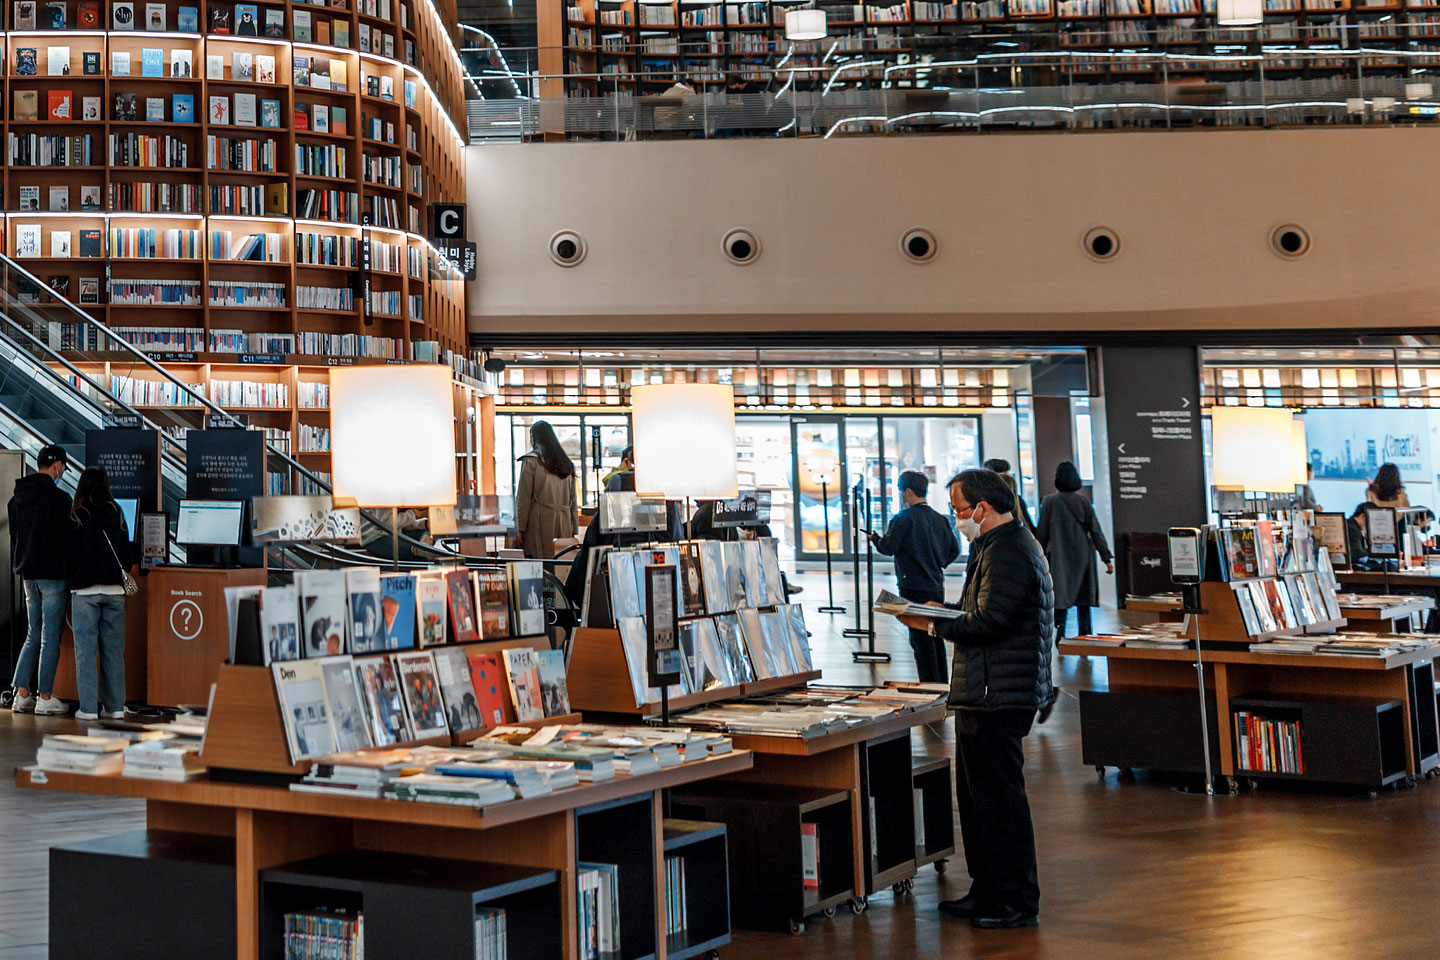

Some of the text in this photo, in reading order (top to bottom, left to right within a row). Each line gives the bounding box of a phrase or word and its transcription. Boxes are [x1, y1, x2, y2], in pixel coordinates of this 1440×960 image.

[440, 210, 458, 234] C
[386, 576, 412, 590] Pitch
[510, 652, 534, 666] PAPER
[280, 667, 296, 680] Den
[402, 660, 434, 674] Gardening
